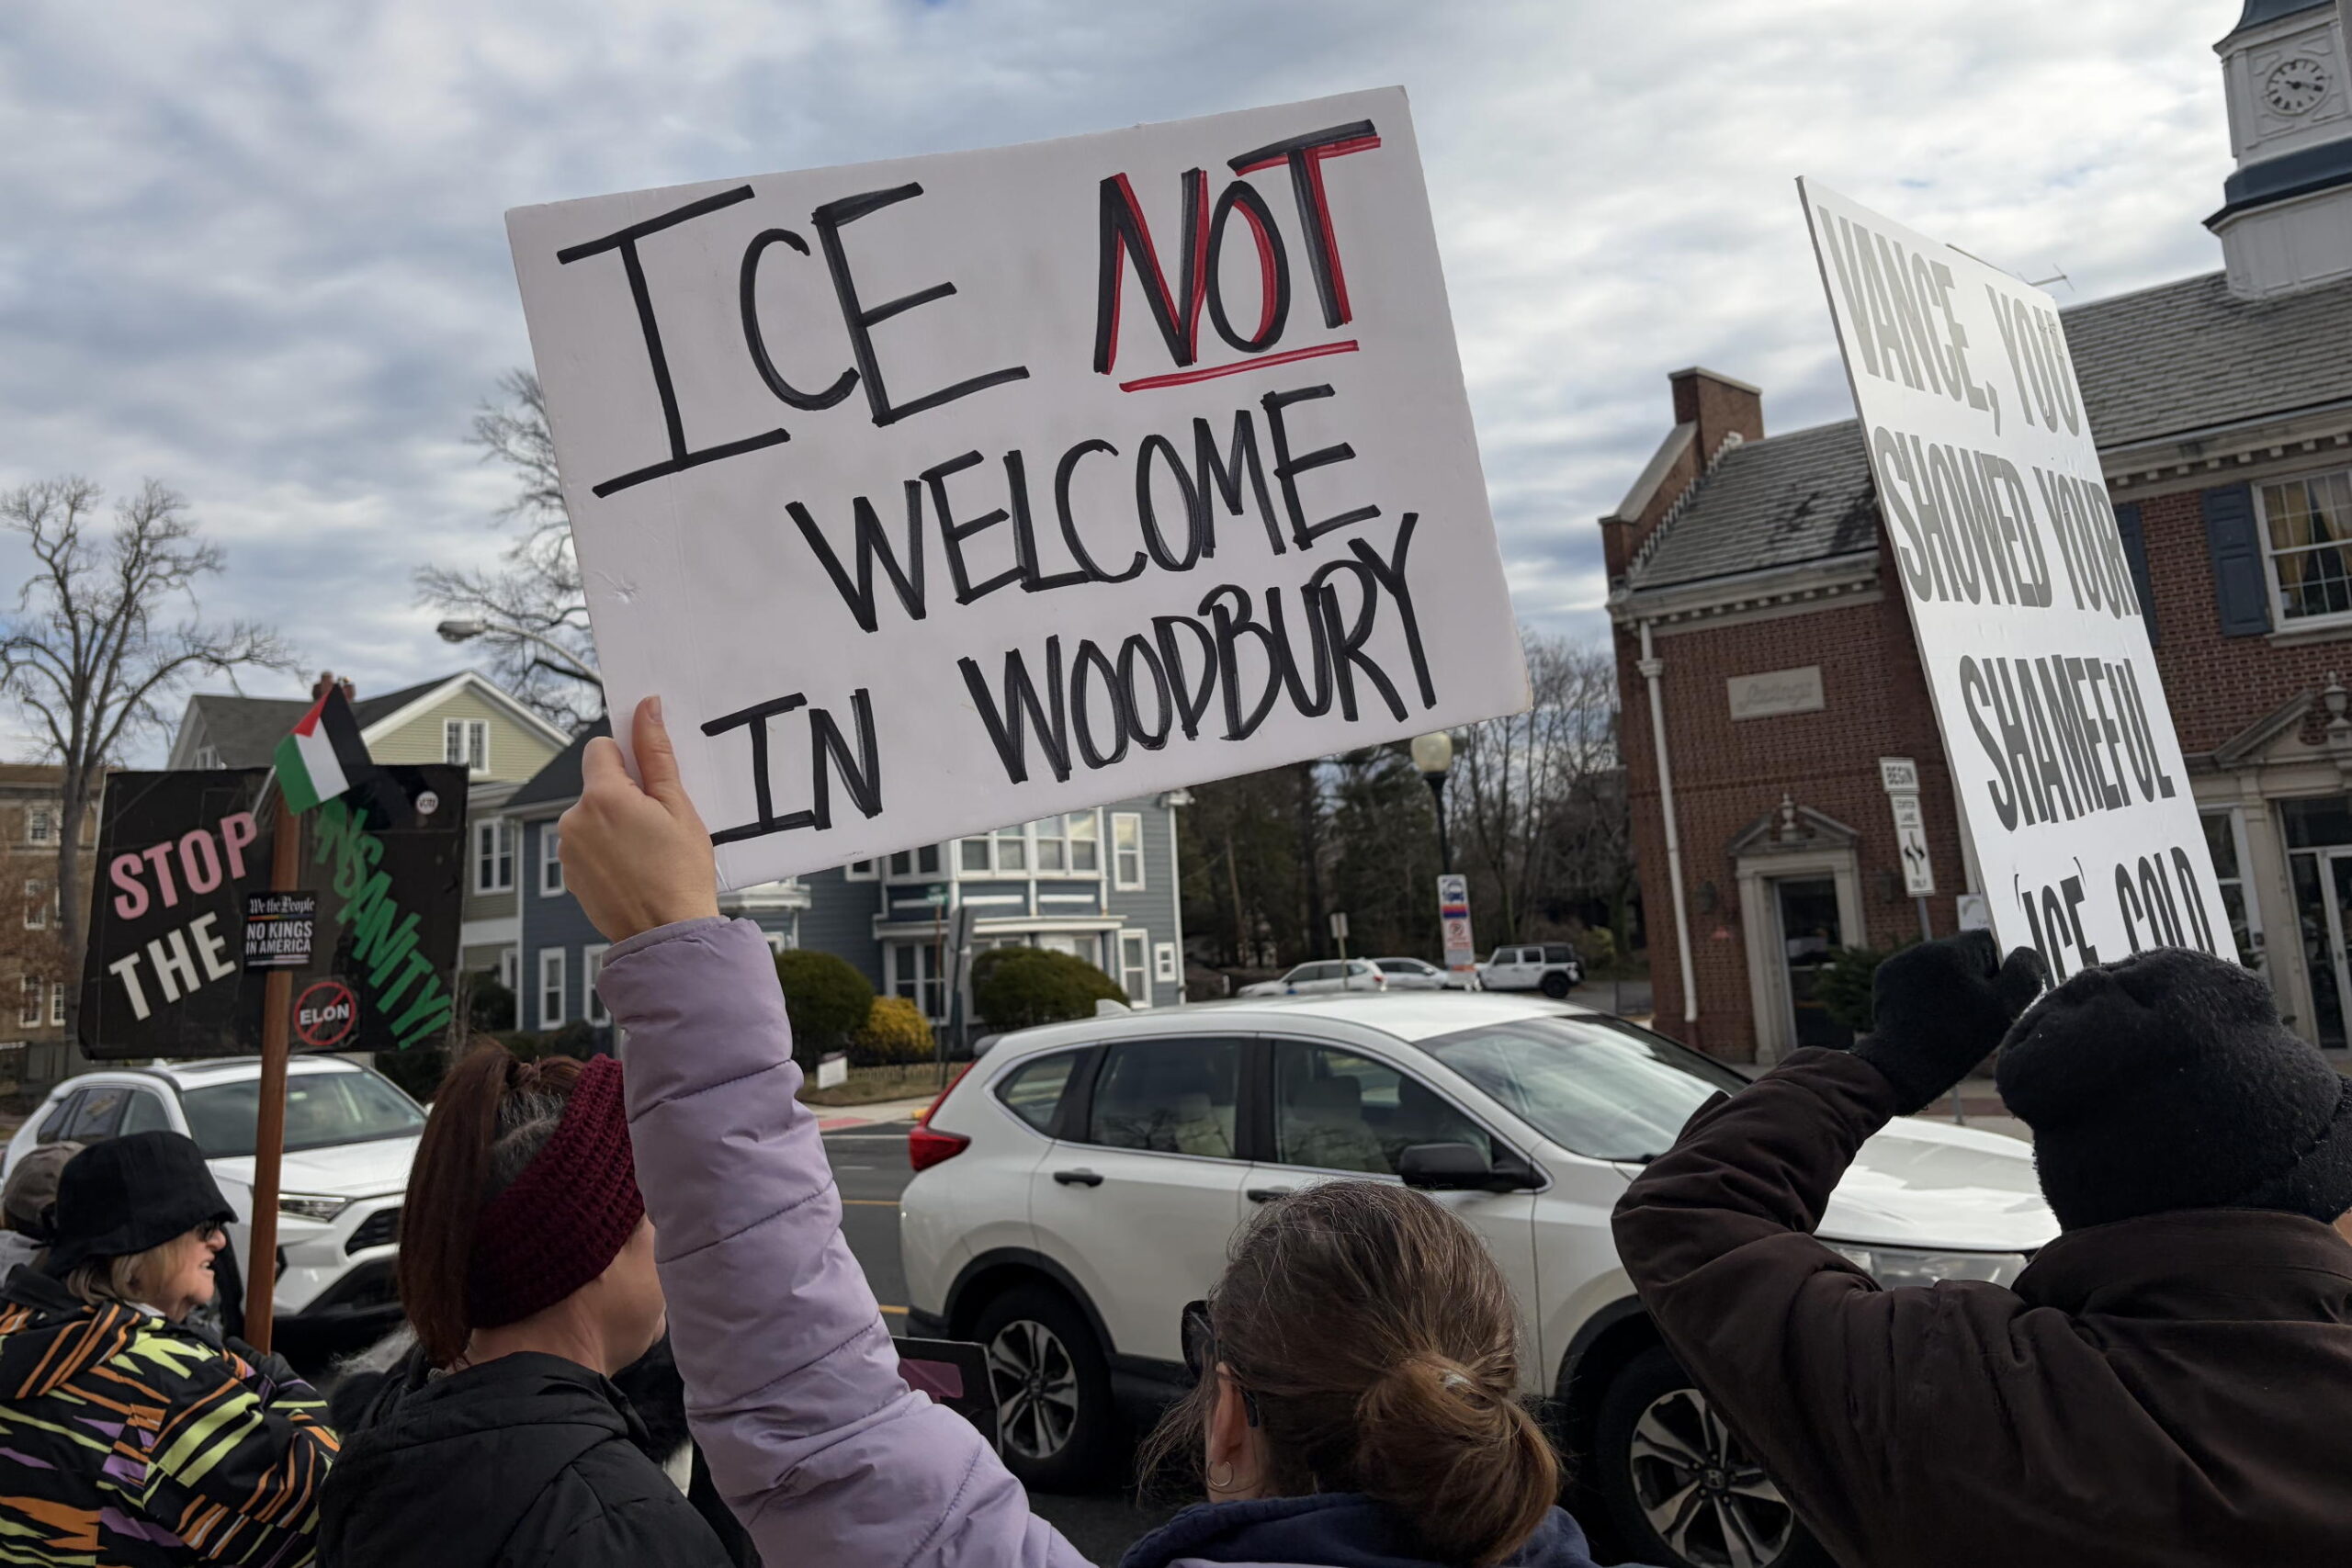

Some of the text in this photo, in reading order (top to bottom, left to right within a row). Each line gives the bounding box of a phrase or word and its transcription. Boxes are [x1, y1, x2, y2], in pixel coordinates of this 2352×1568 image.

[557, 119, 1381, 498] ICE NOT
[1817, 205, 2080, 437] VANCE, YOU
[786, 384, 1381, 633] WELCOME
[1874, 426, 2140, 620] SHOWED YOUR
[701, 513, 1436, 845] IN WOODBURY
[1959, 654, 2176, 832] SHAMEFUL
[110, 811, 258, 919] STOP
[246, 920, 312, 941] NO KINGS
[249, 895, 315, 914] We the People
[108, 911, 237, 1021] THE
[245, 938, 311, 955] IN AMERICA
[300, 1003, 349, 1026] ELON
